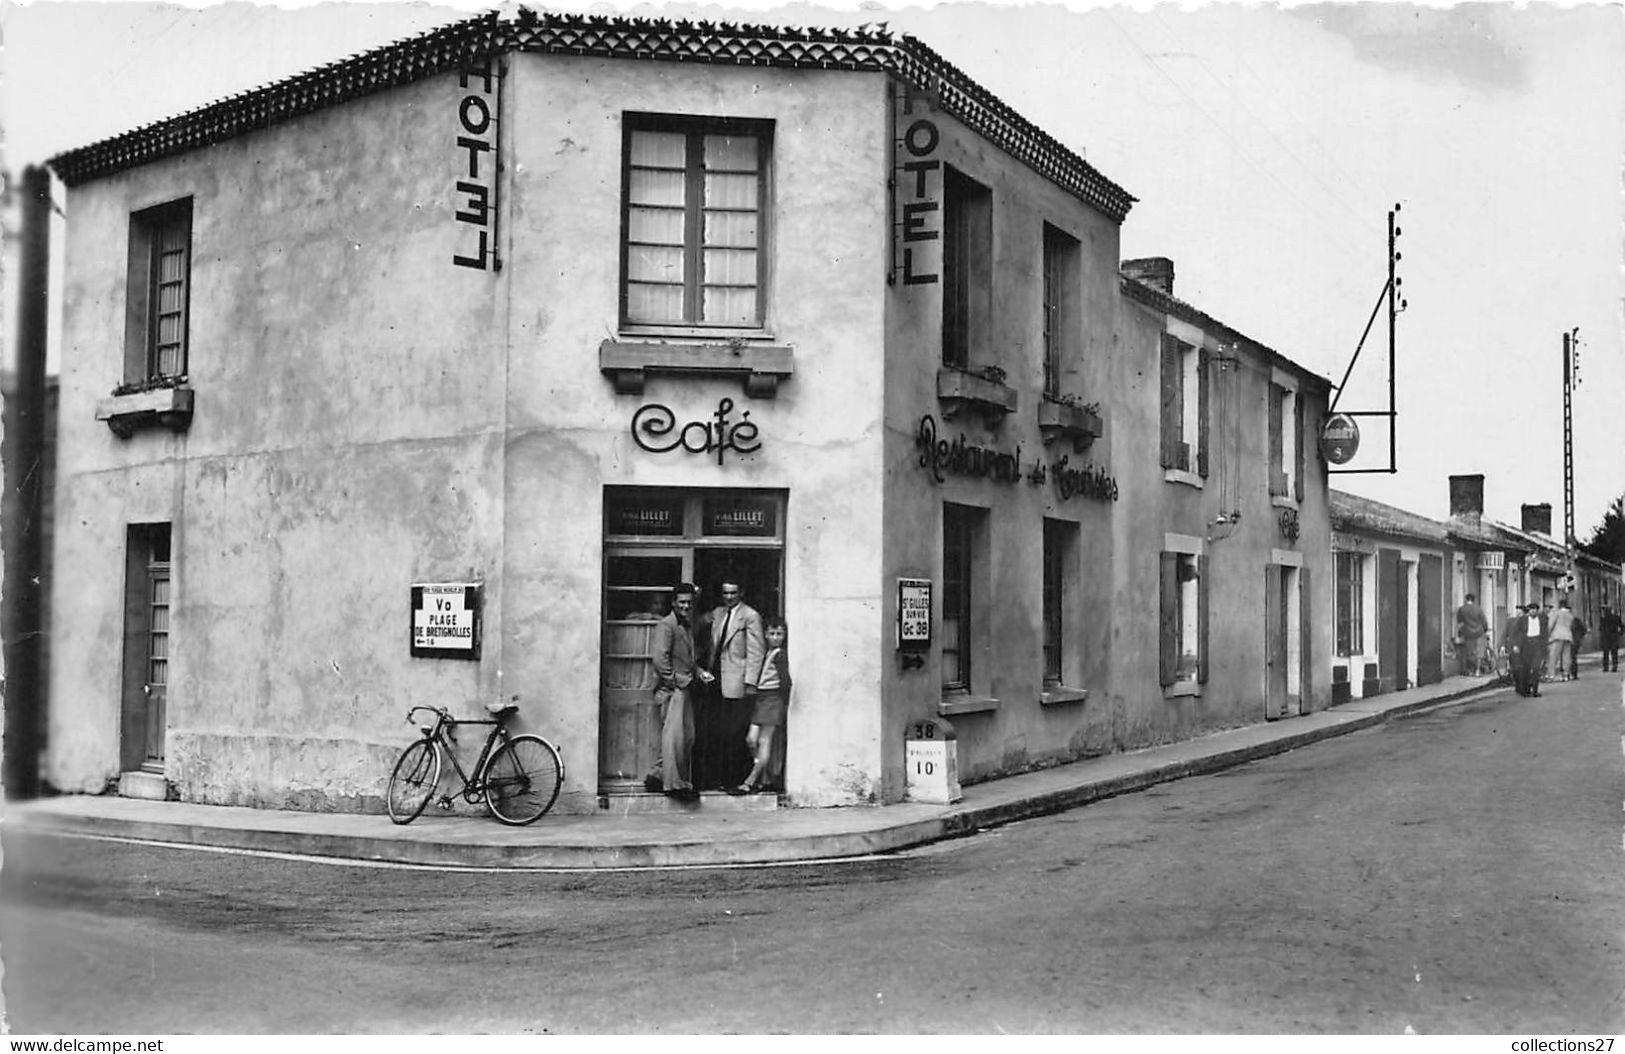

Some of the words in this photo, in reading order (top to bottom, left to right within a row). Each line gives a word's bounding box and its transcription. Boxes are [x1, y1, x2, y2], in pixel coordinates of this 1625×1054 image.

[903, 76, 940, 286] HOTEL
[630, 397, 763, 466] Café
[640, 510, 670, 521] LILLET
[733, 511, 762, 522] LILLET
[429, 614, 457, 626] PLAGE
[415, 626, 424, 637] DE
[426, 626, 471, 638] BRETIGNOLLES
[915, 621, 928, 636] 38
[914, 723, 934, 739] 38
